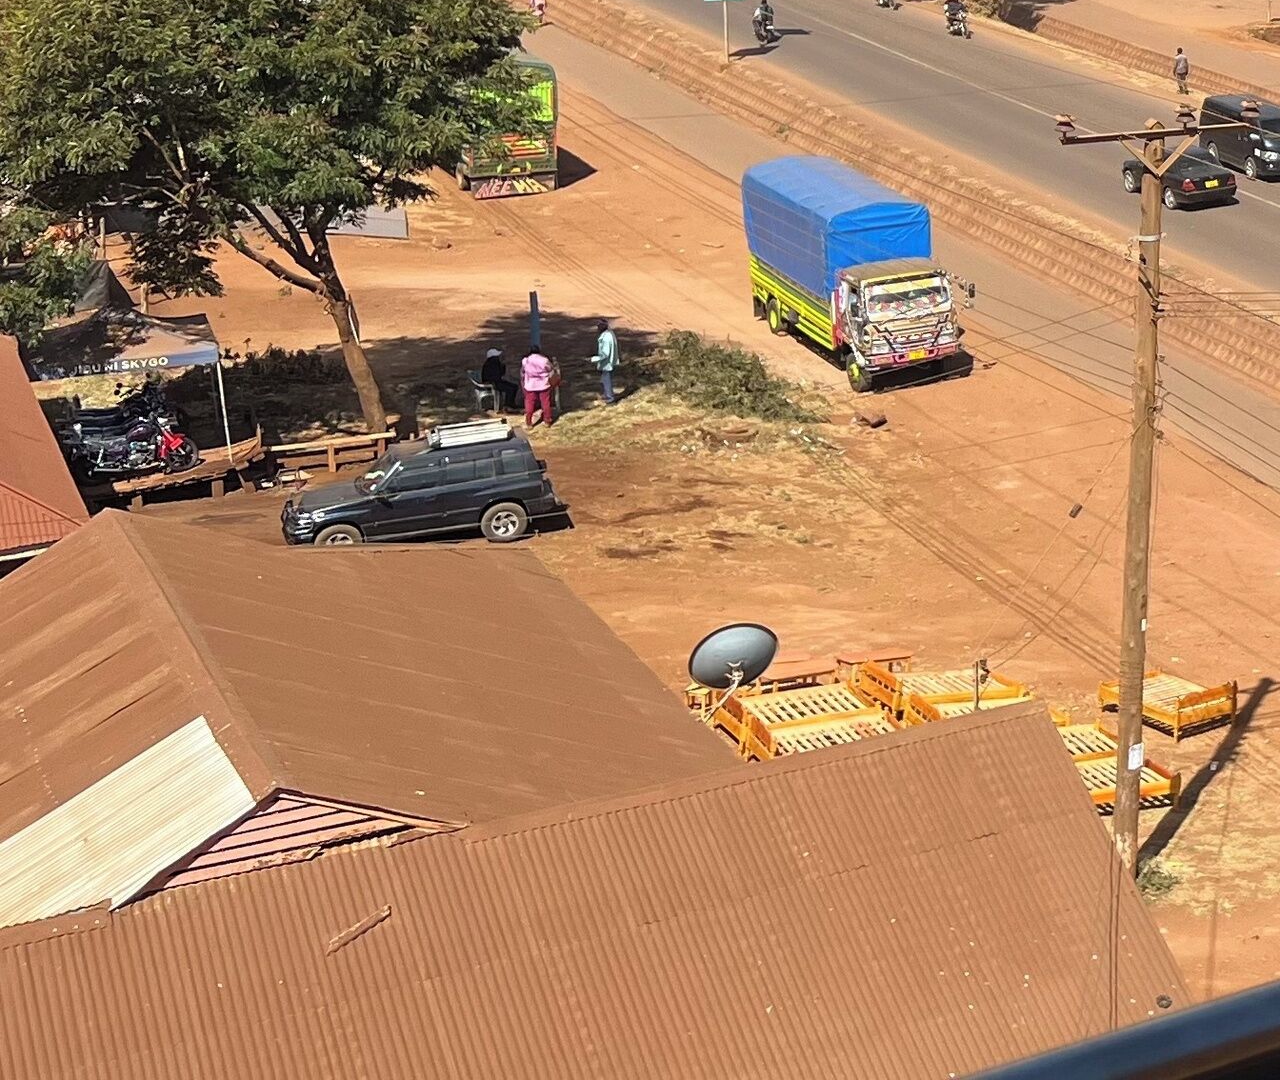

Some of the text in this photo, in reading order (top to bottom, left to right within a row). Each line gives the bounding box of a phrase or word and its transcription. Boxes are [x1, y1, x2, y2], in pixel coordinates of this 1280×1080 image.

[474, 176, 549, 199] NEEMA
[104, 360, 118, 371] NI
[121, 356, 169, 370] SKYGO
